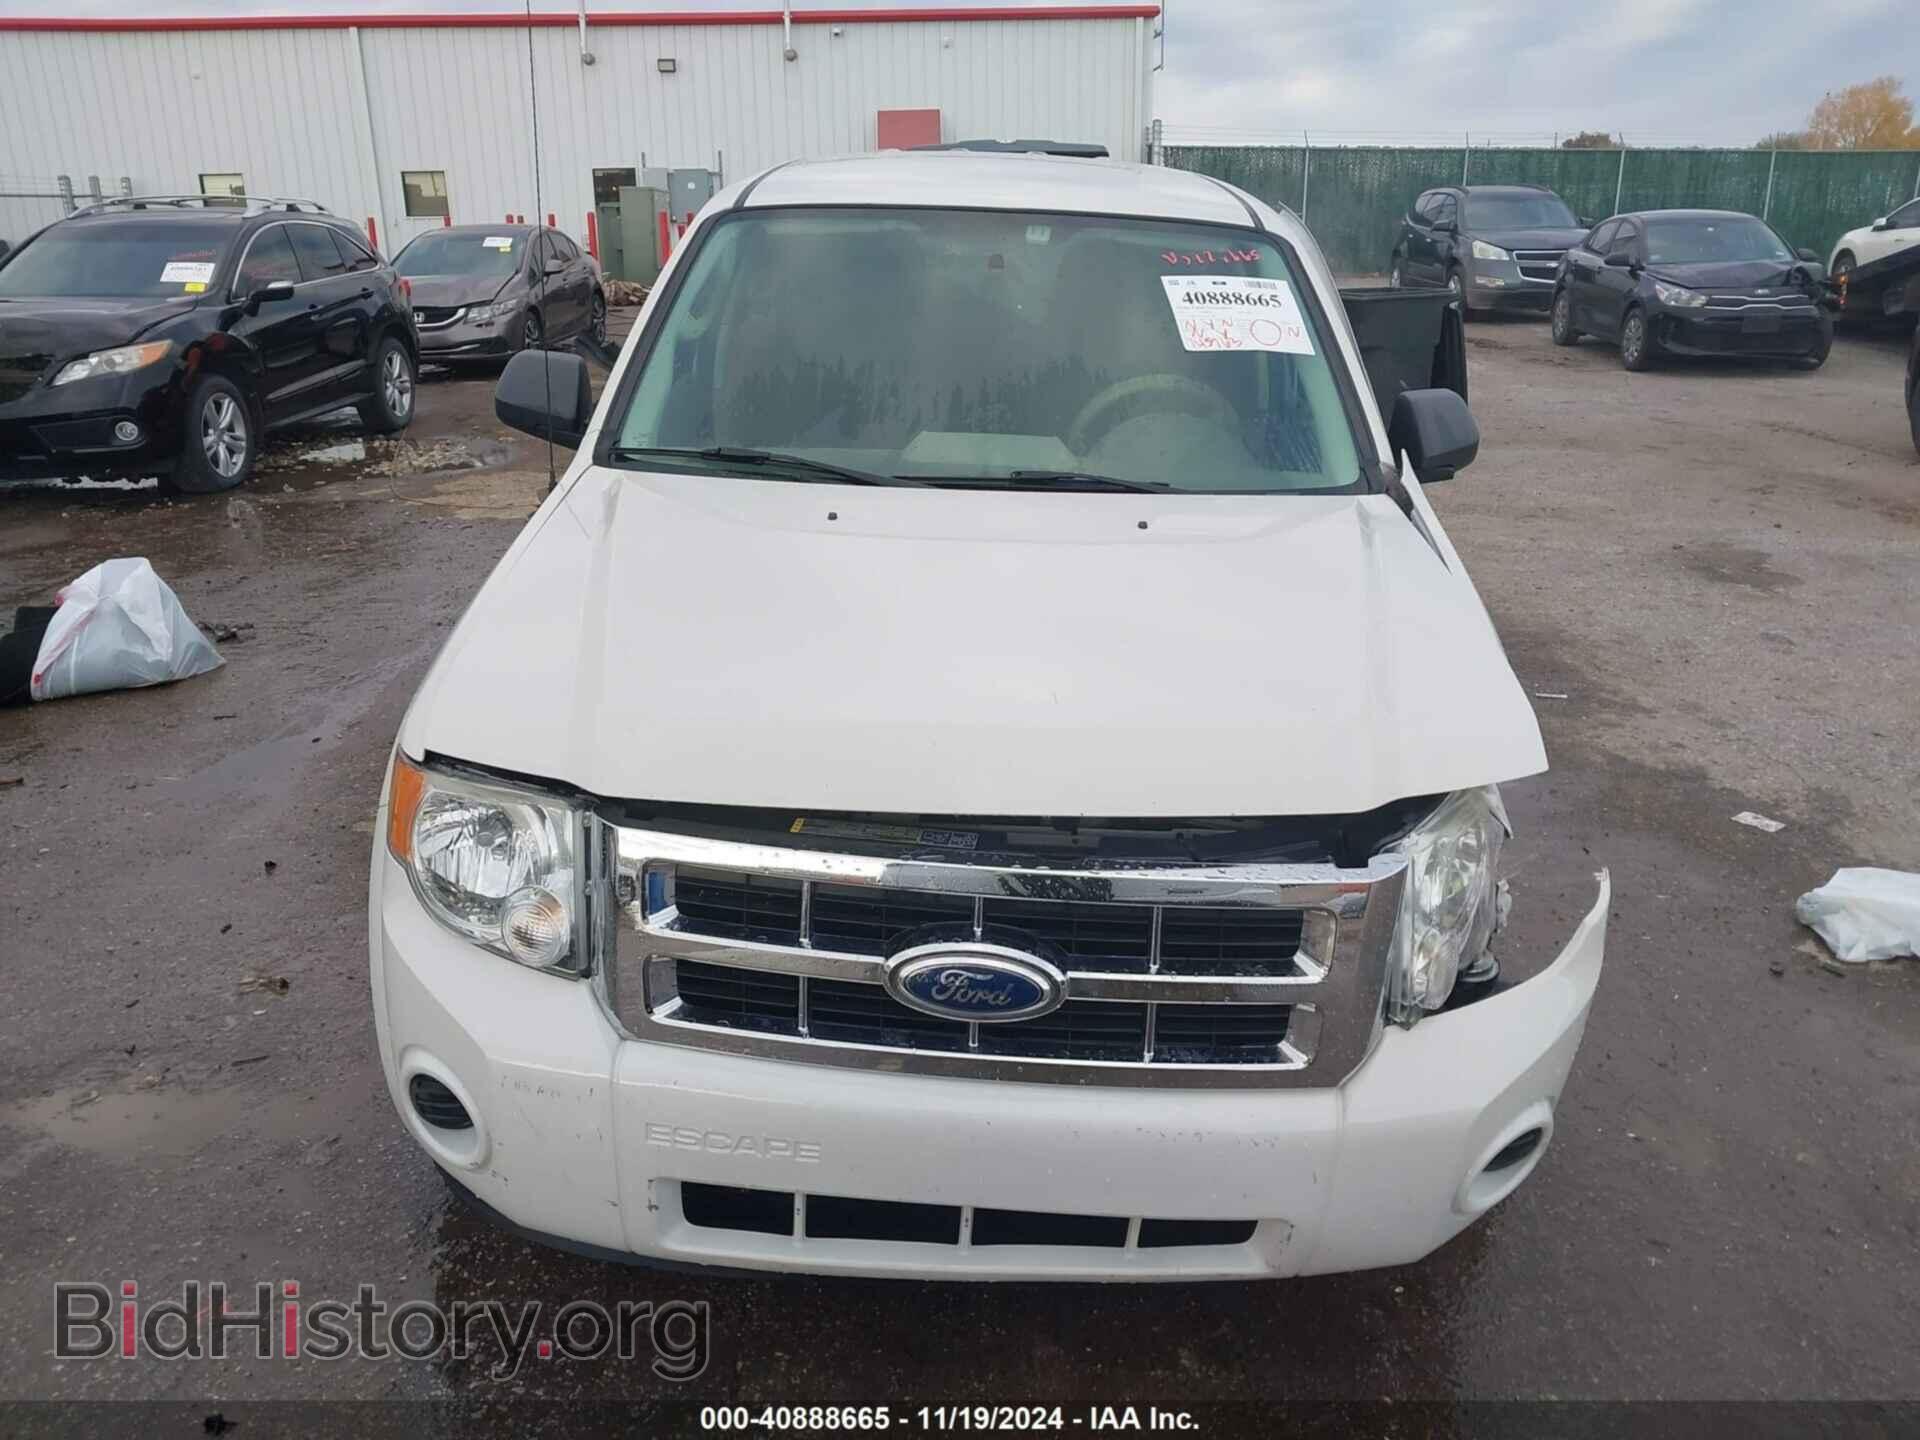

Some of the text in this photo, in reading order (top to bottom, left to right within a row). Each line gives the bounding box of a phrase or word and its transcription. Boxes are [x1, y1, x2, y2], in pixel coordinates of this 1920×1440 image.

[1182, 290, 1282, 308] 40888665
[931, 969, 1012, 1006] Ford
[644, 1122, 822, 1162] ESCAPE
